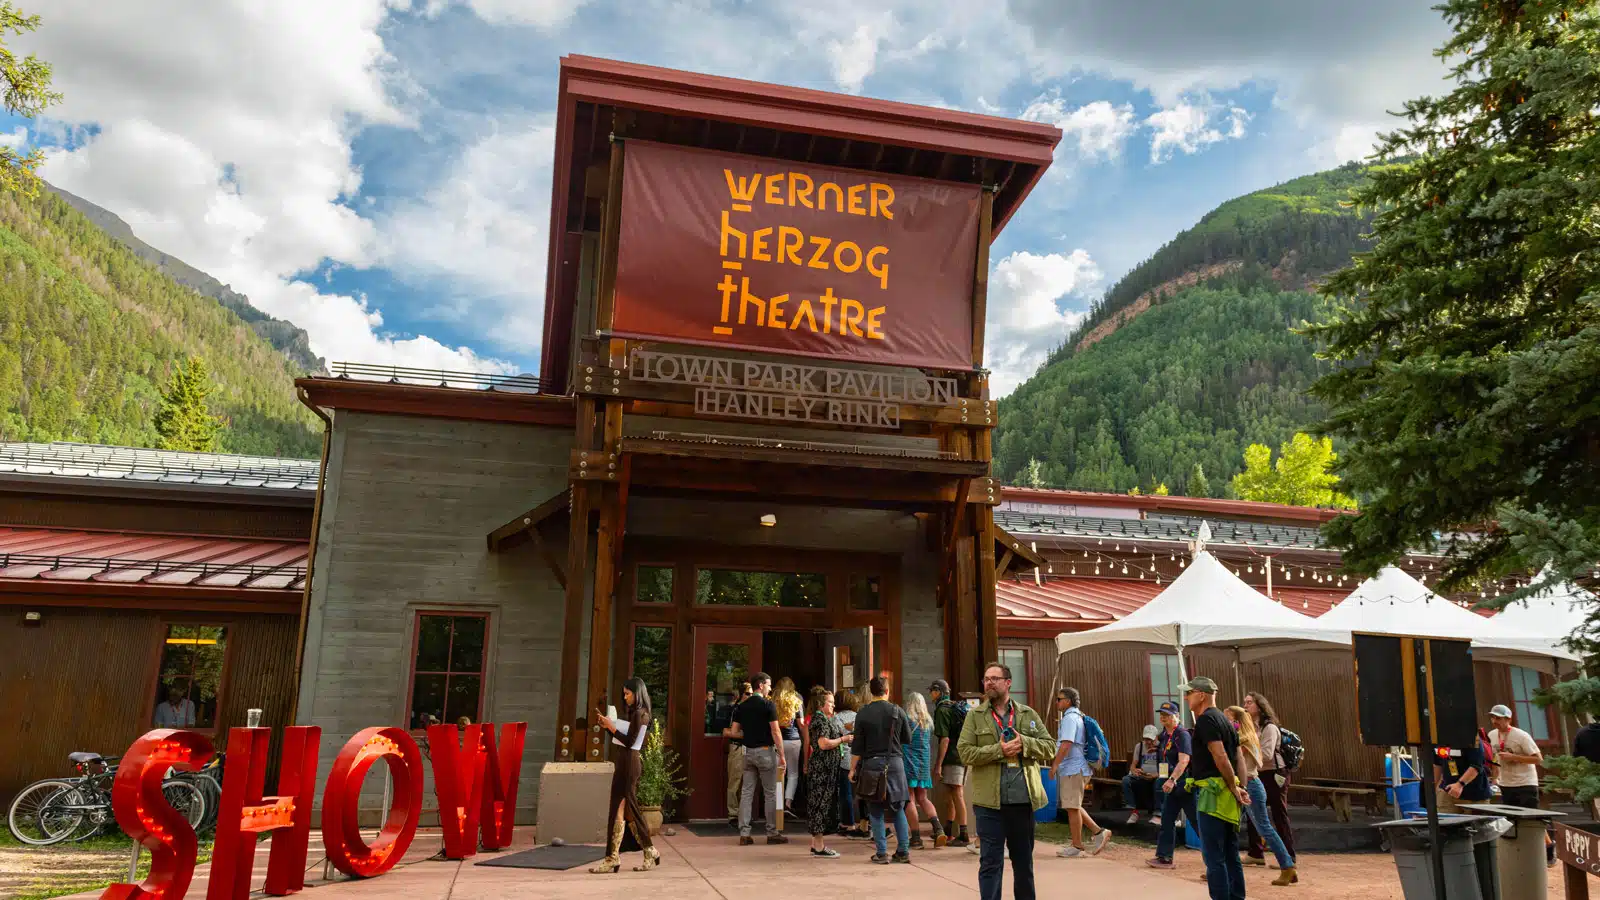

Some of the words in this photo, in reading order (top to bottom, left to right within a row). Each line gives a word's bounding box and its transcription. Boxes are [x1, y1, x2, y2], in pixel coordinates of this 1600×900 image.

[637, 352, 732, 387] TOWN
[744, 362, 819, 394] PARK
[826, 371, 953, 405] PAVILION
[703, 389, 816, 421] HANLEY
[828, 401, 893, 427] RINK
[99, 722, 528, 900] SHOW
[1565, 829, 1590, 859] PUPPY
